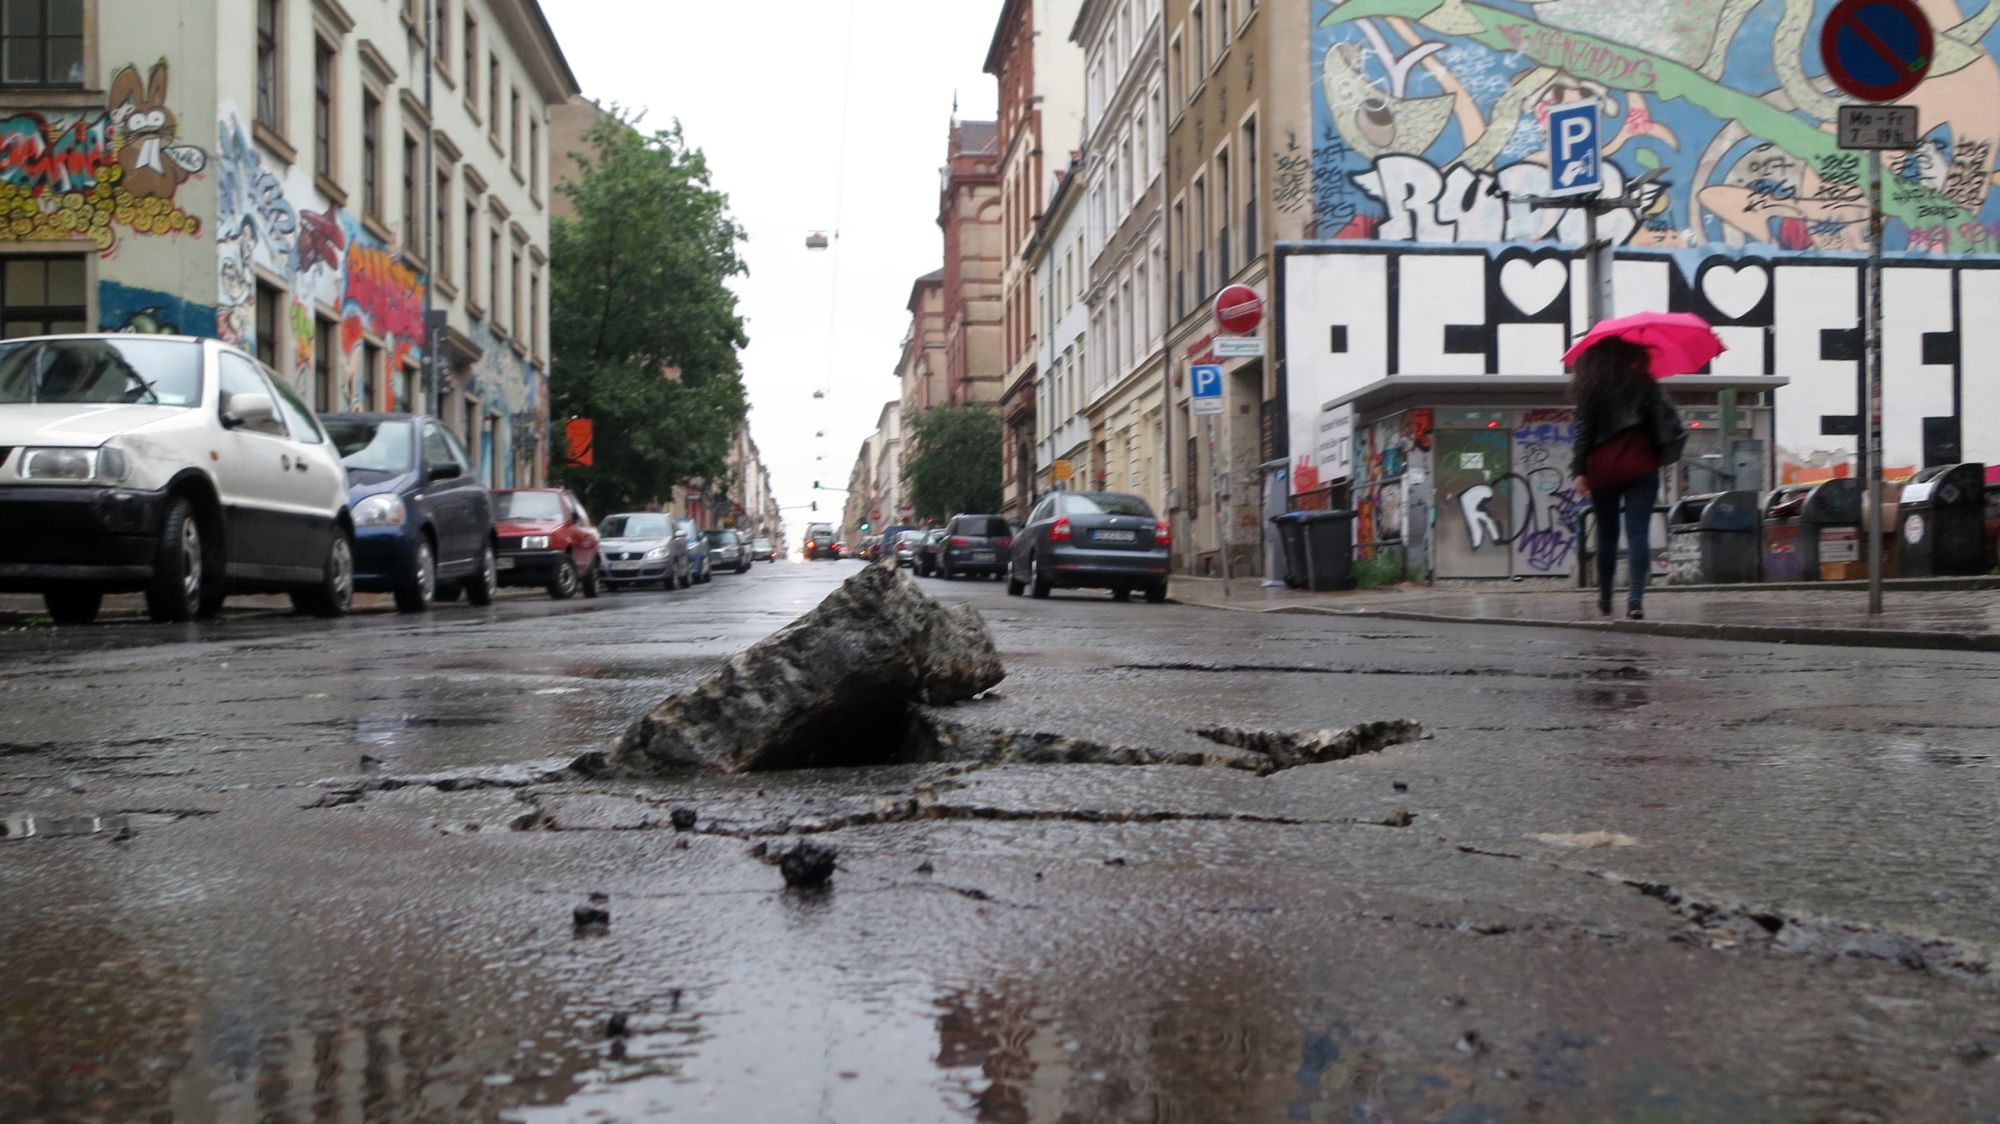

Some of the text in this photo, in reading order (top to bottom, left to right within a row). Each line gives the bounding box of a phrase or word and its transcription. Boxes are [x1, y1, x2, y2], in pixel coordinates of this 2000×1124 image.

[1849, 111, 1873, 126] Mo
[1887, 111, 1905, 126] Fr
[1561, 116, 1592, 161] P
[1850, 128, 1860, 143] 7
[1197, 369, 1216, 395] P
